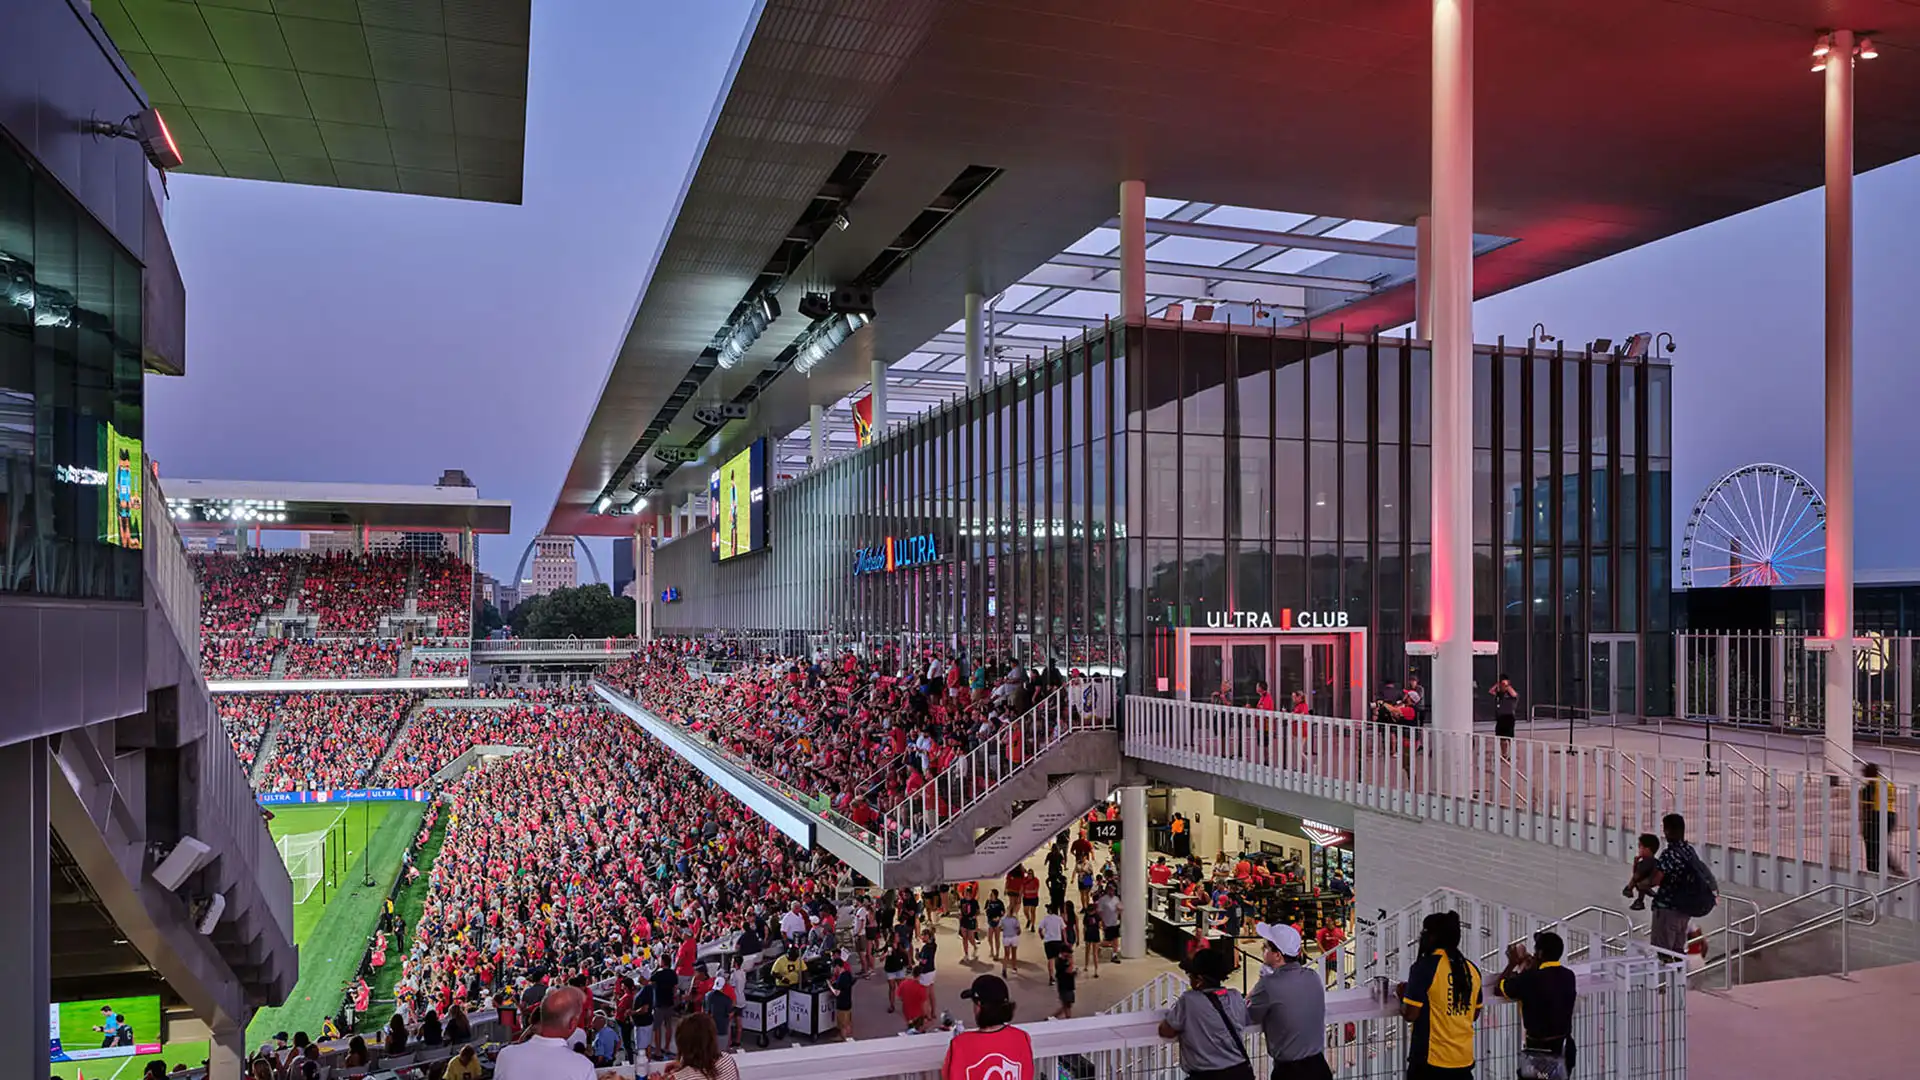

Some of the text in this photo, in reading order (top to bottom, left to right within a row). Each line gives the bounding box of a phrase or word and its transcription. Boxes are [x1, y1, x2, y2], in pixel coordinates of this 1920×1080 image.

[894, 532, 937, 567] ULTRA
[1207, 611, 1349, 628] ULTRA CLUB
[372, 790, 397, 798] ULTRA
[1096, 825, 1117, 837] 142
[768, 1003, 785, 1017] ULTRA
[790, 1005, 809, 1016] ULTRA
[821, 1001, 836, 1013] ULT
